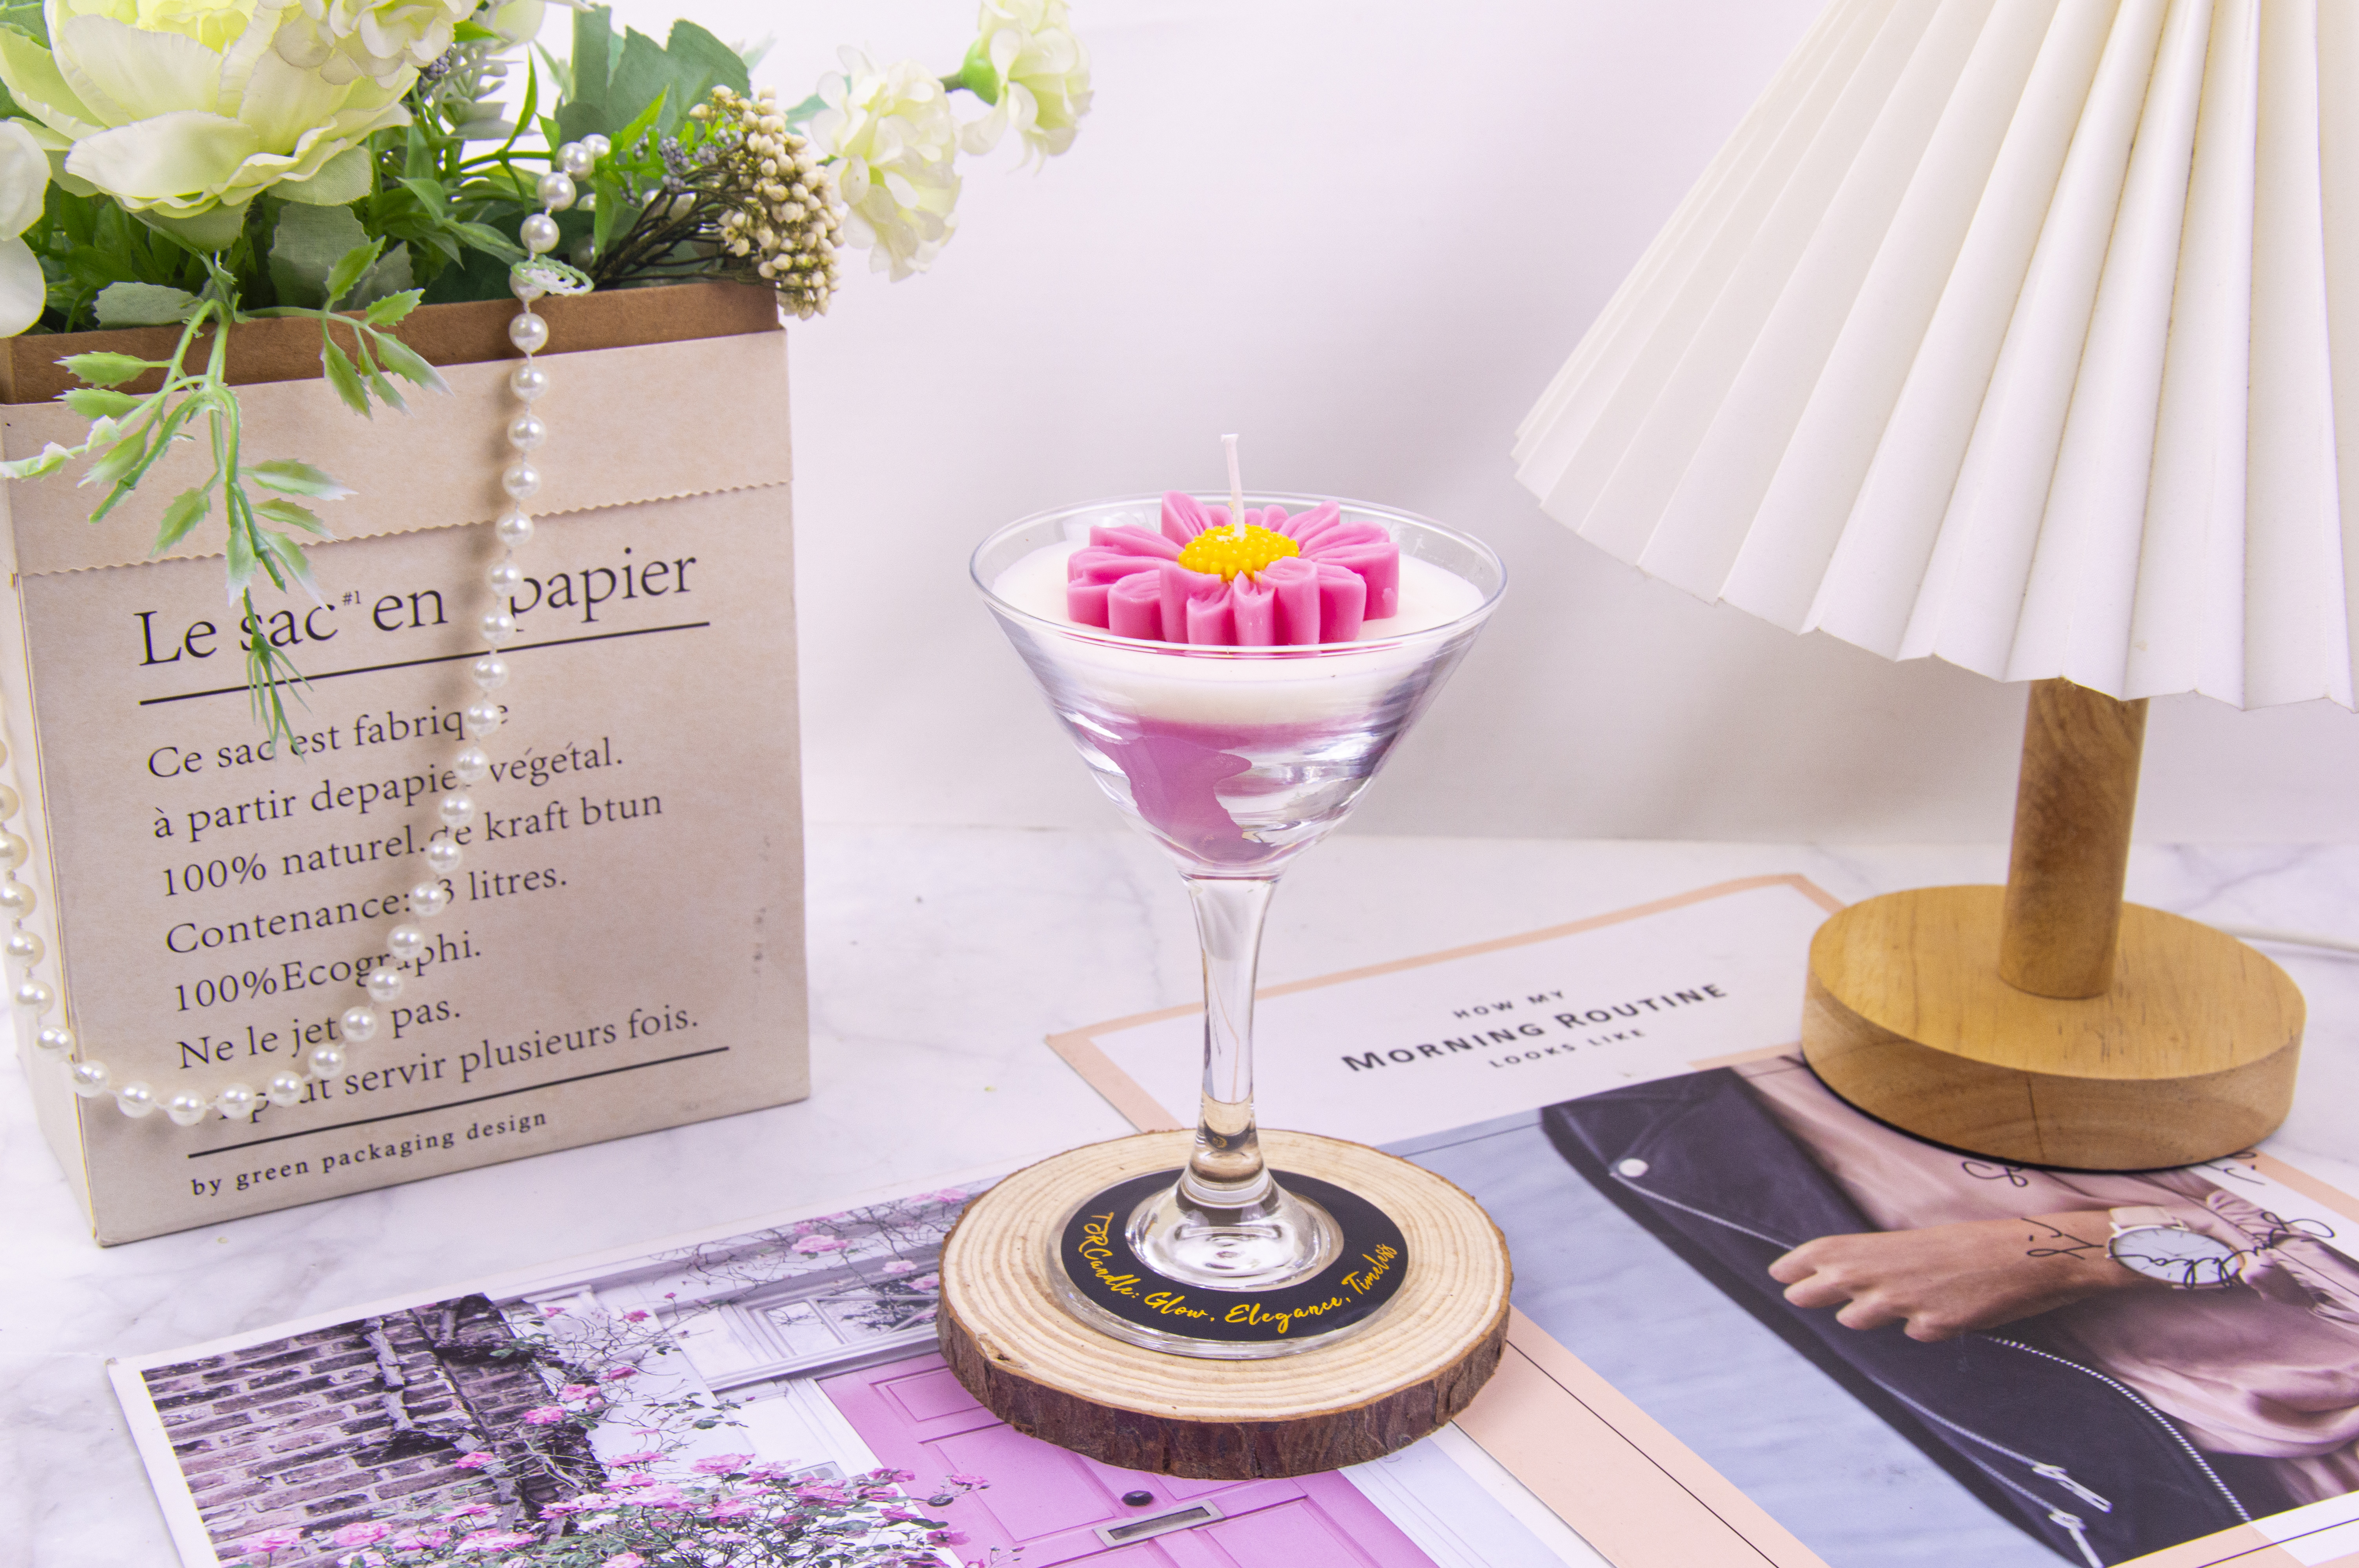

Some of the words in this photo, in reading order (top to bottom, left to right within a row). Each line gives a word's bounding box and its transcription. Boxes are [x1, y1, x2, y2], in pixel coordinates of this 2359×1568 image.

[134, 610, 217, 666] Le
[240, 604, 338, 651] sac
[373, 590, 449, 632] en
[148, 746, 202, 778] Ce
[218, 740, 274, 768] sac
[290, 726, 340, 756] est
[354, 705, 508, 746] fabriqe
[154, 807, 174, 838] à
[187, 789, 296, 843] partir
[311, 763, 472, 815] depapie
[489, 736, 623, 788] végétal.
[164, 853, 267, 897] 100%
[282, 824, 425, 876] naturel.
[484, 800, 569, 841] kraft
[580, 795, 662, 826] btun
[166, 893, 411, 953] Contenance:
[469, 868, 567, 901] litres.
[177, 1036, 234, 1069] Ne
[247, 1025, 278, 1056] le
[291, 1018, 345, 1058] jet
[391, 1000, 460, 1039] pas.
[1341, 1024, 1545, 1072] MORNING
[1554, 984, 1726, 1029] ROUTINE
[1453, 1001, 1513, 1019] HOW
[1527, 991, 1563, 1004] MY
[345, 1053, 446, 1095] servir
[459, 1023, 617, 1083] plusieurs
[628, 1004, 698, 1039] fois.
[1489, 1043, 1576, 1068] LOOKS
[1587, 1028, 1645, 1046] LIKE
[191, 1178, 222, 1197] by
[236, 1161, 309, 1191] green
[322, 1131, 455, 1173] packaging
[466, 1113, 547, 1140] design
[1341, 1243, 1397, 1294] Timeless
